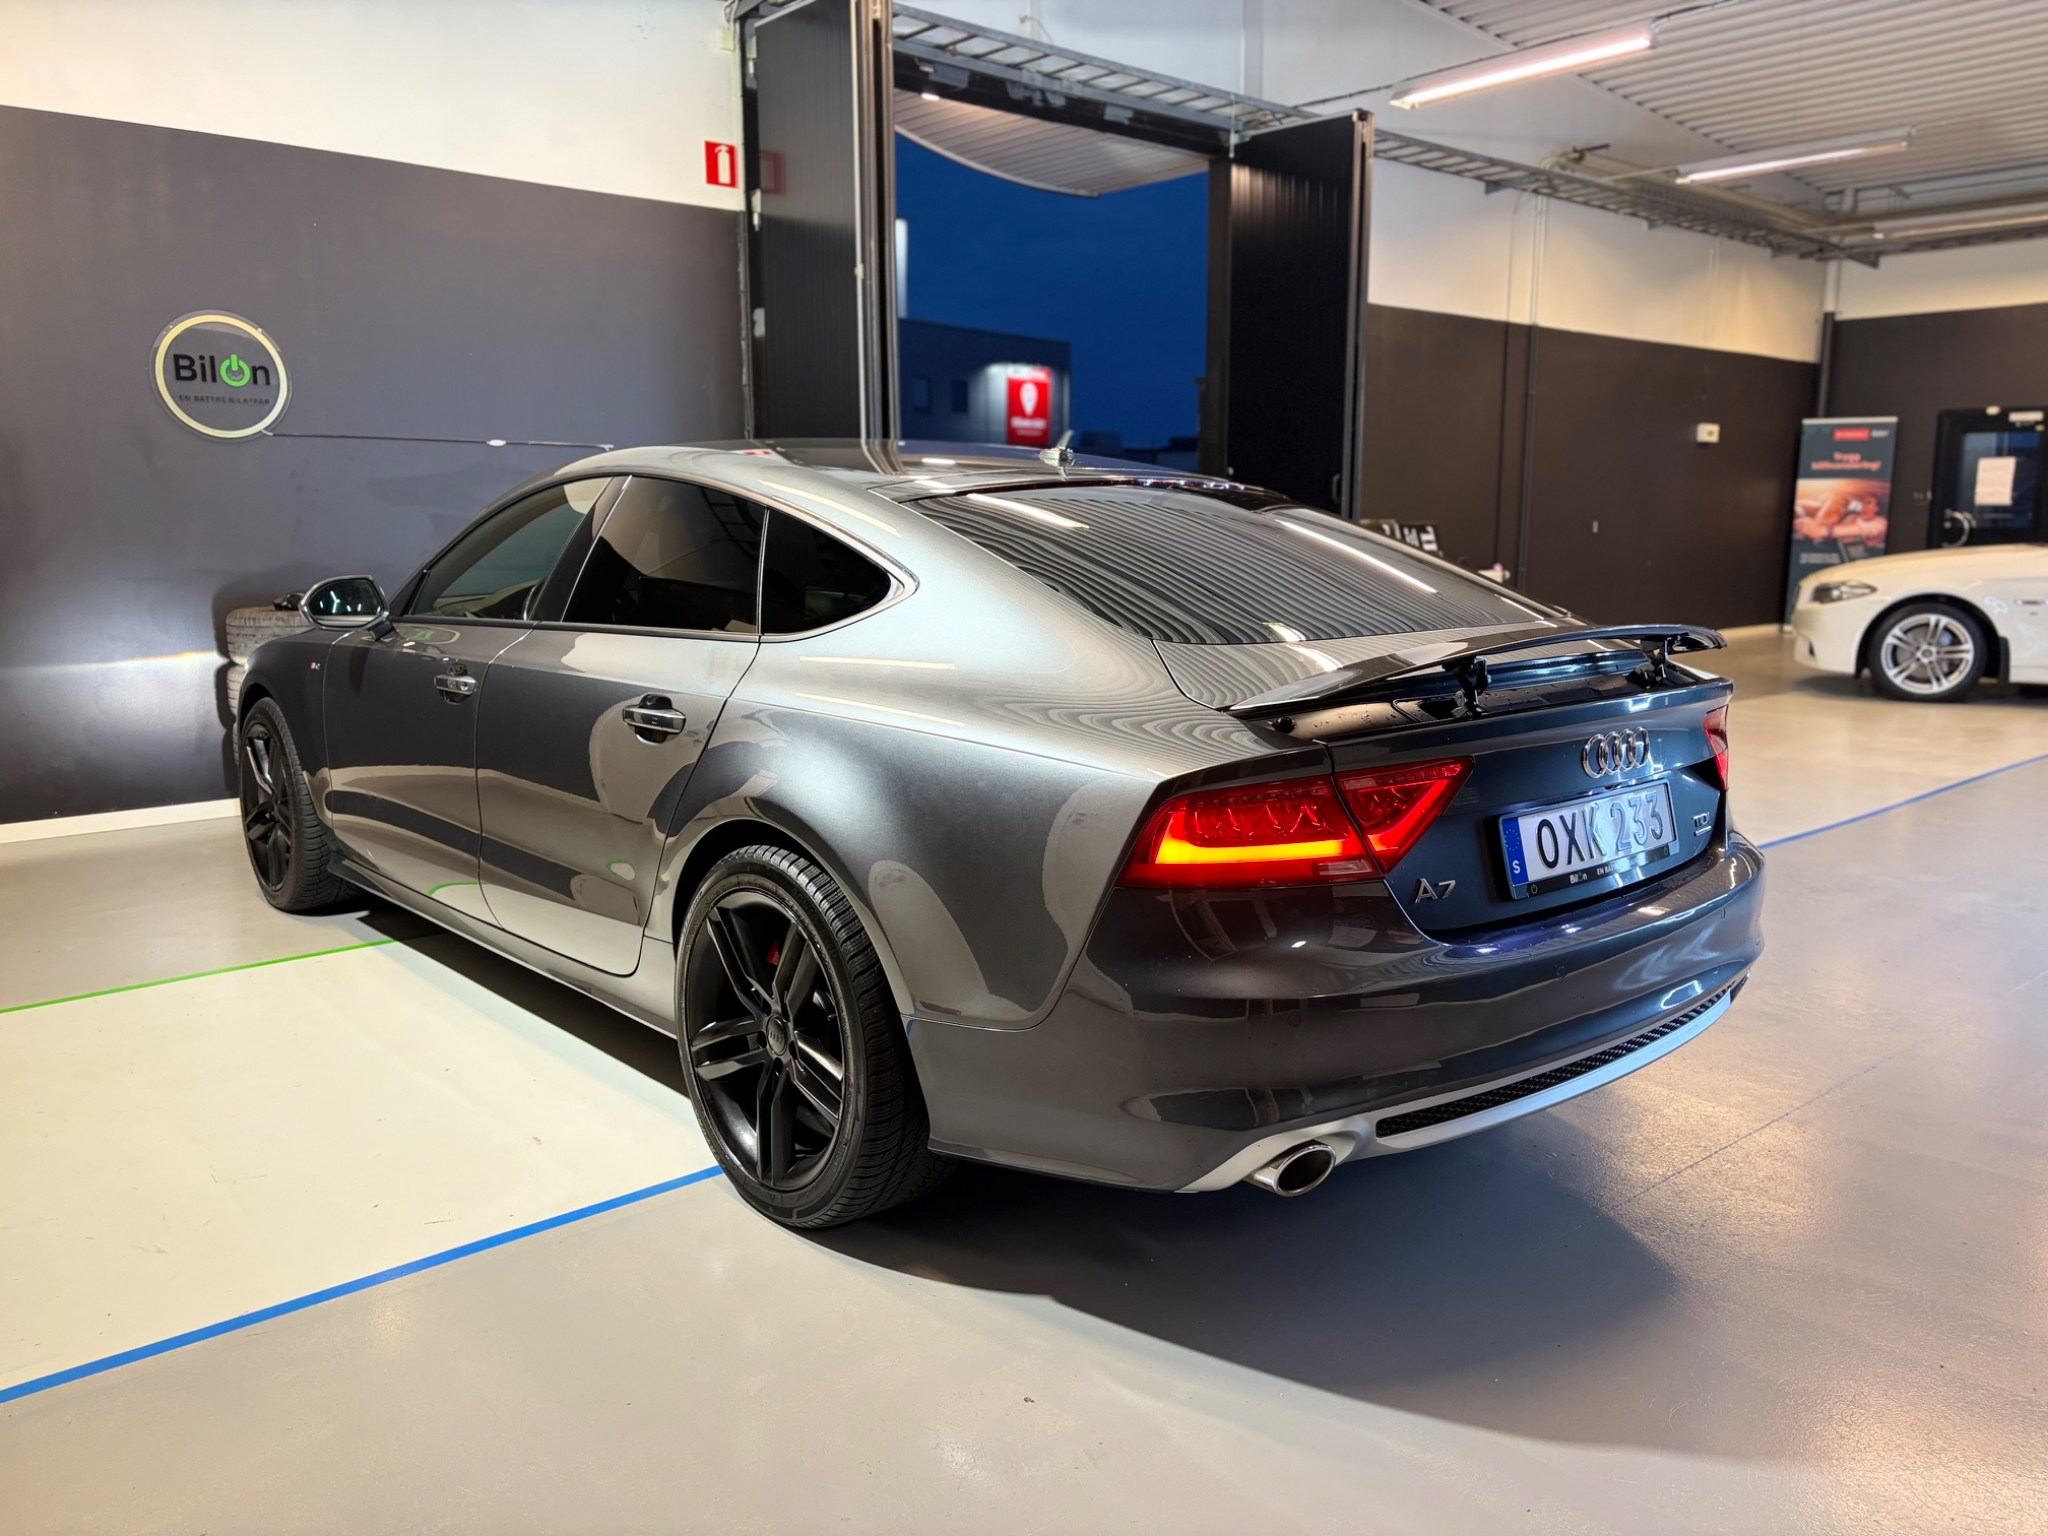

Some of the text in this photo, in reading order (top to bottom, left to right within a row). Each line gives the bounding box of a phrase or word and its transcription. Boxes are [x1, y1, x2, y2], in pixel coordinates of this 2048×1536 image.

[173, 353, 271, 388] BilOn
[178, 394, 191, 402] EN
[1537, 791, 1664, 869] OXK 233
[1512, 860, 1521, 874] S
[1569, 871, 1588, 884] BilOn
[1412, 878, 1456, 904] A7
